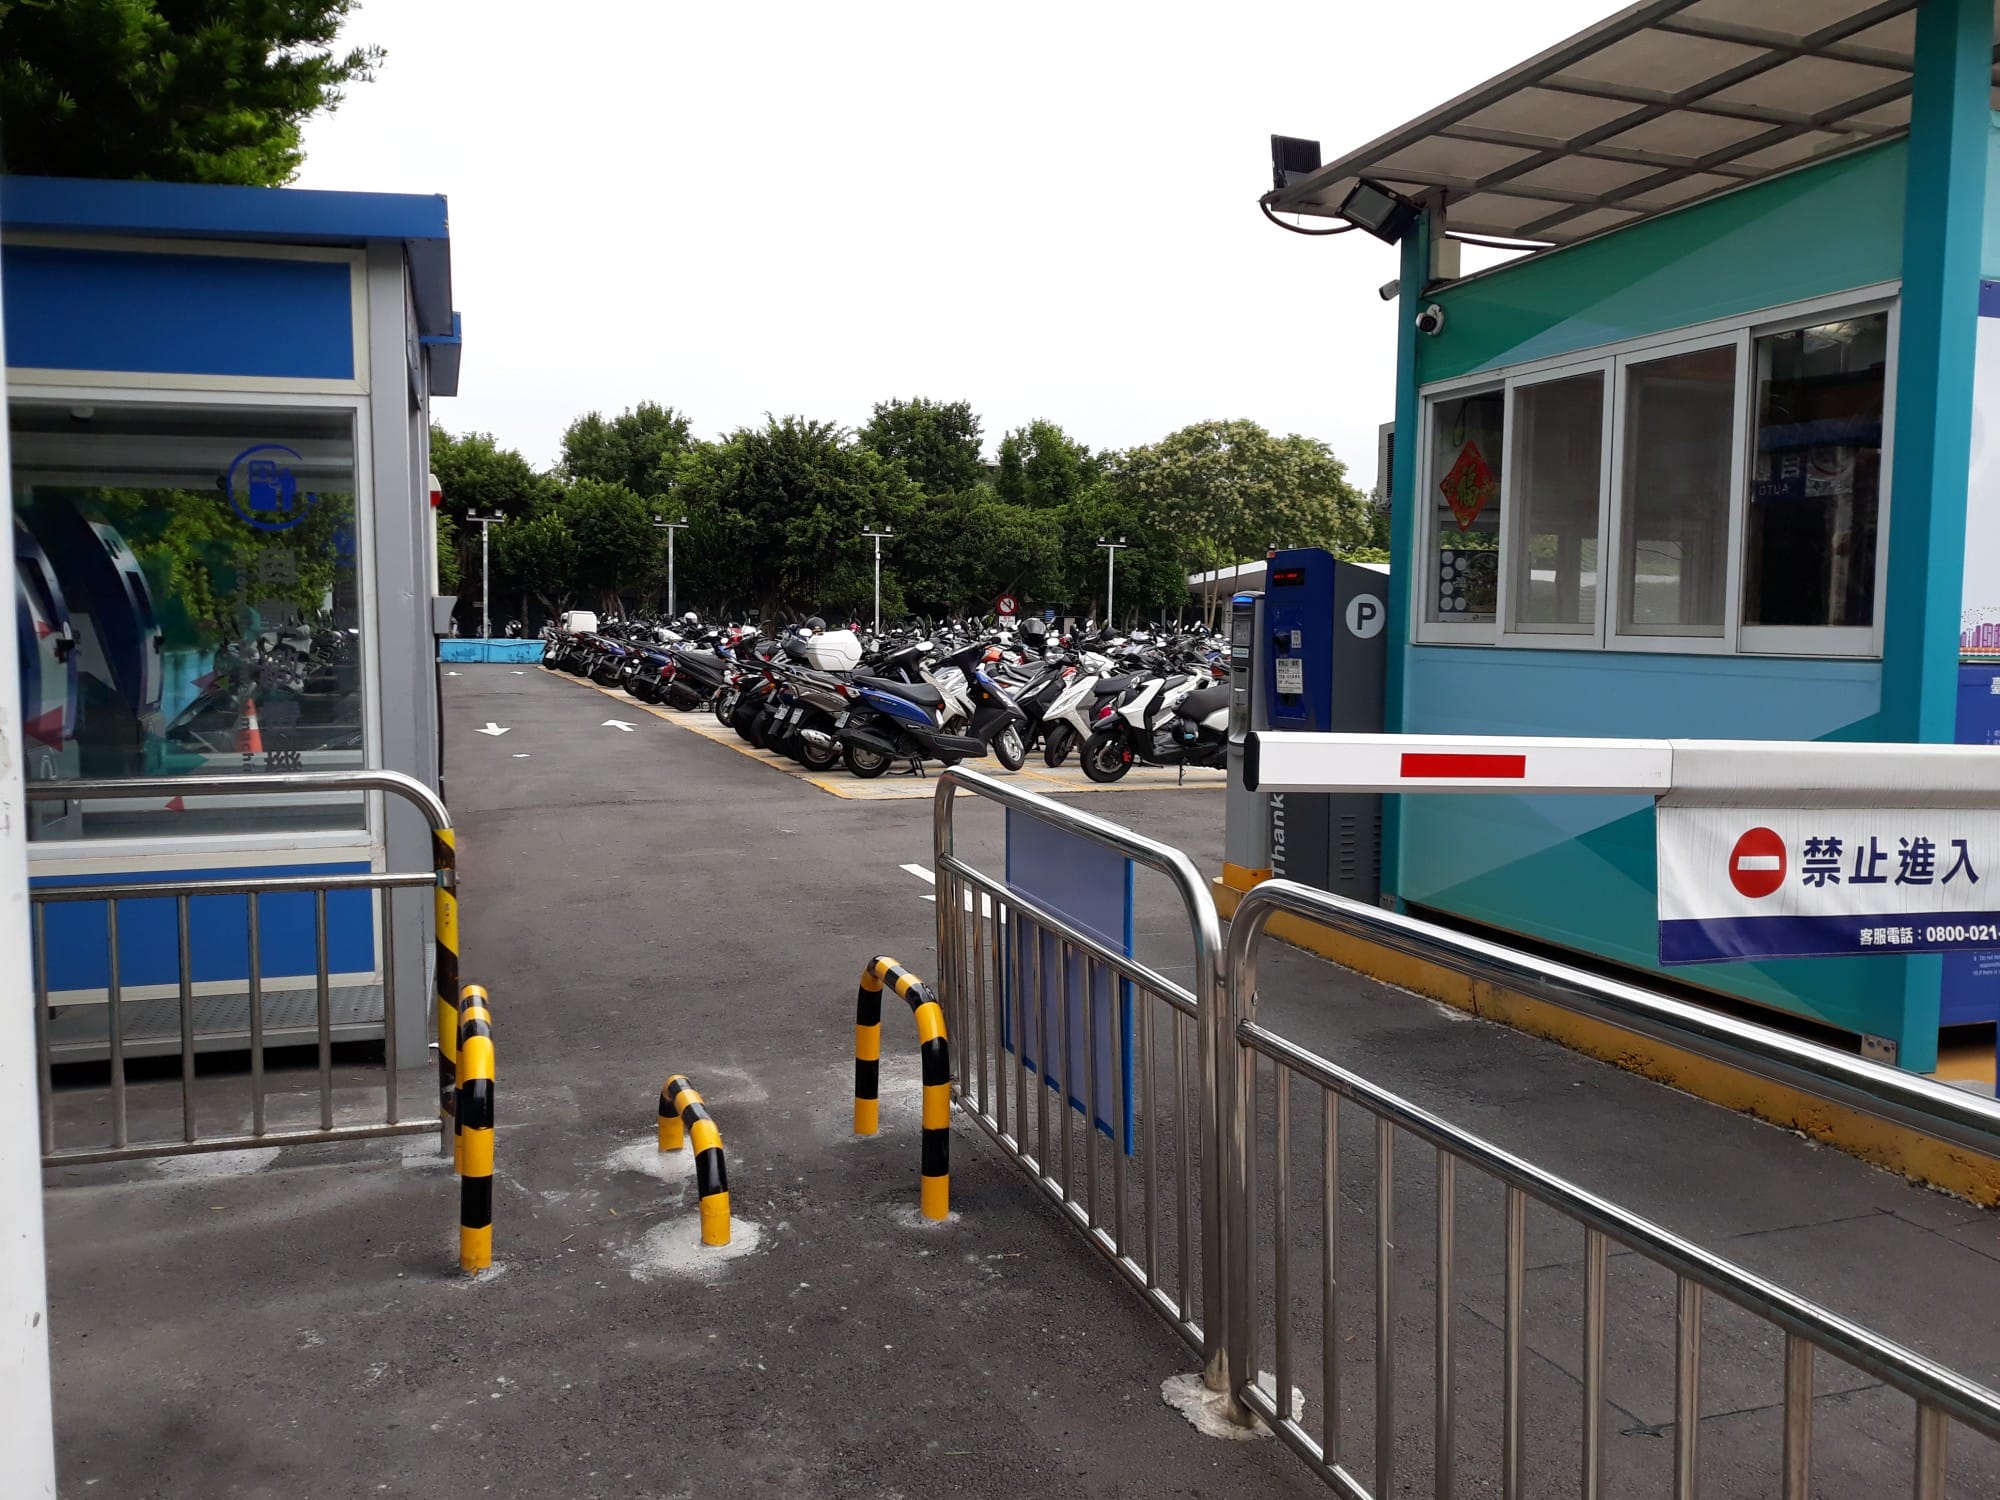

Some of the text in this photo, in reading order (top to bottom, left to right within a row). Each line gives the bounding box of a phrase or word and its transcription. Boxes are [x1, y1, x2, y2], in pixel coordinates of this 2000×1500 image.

[1357, 602, 1377, 630] P
[1270, 793, 1286, 877] Thank
[1801, 836, 1980, 888] 禁止進入
